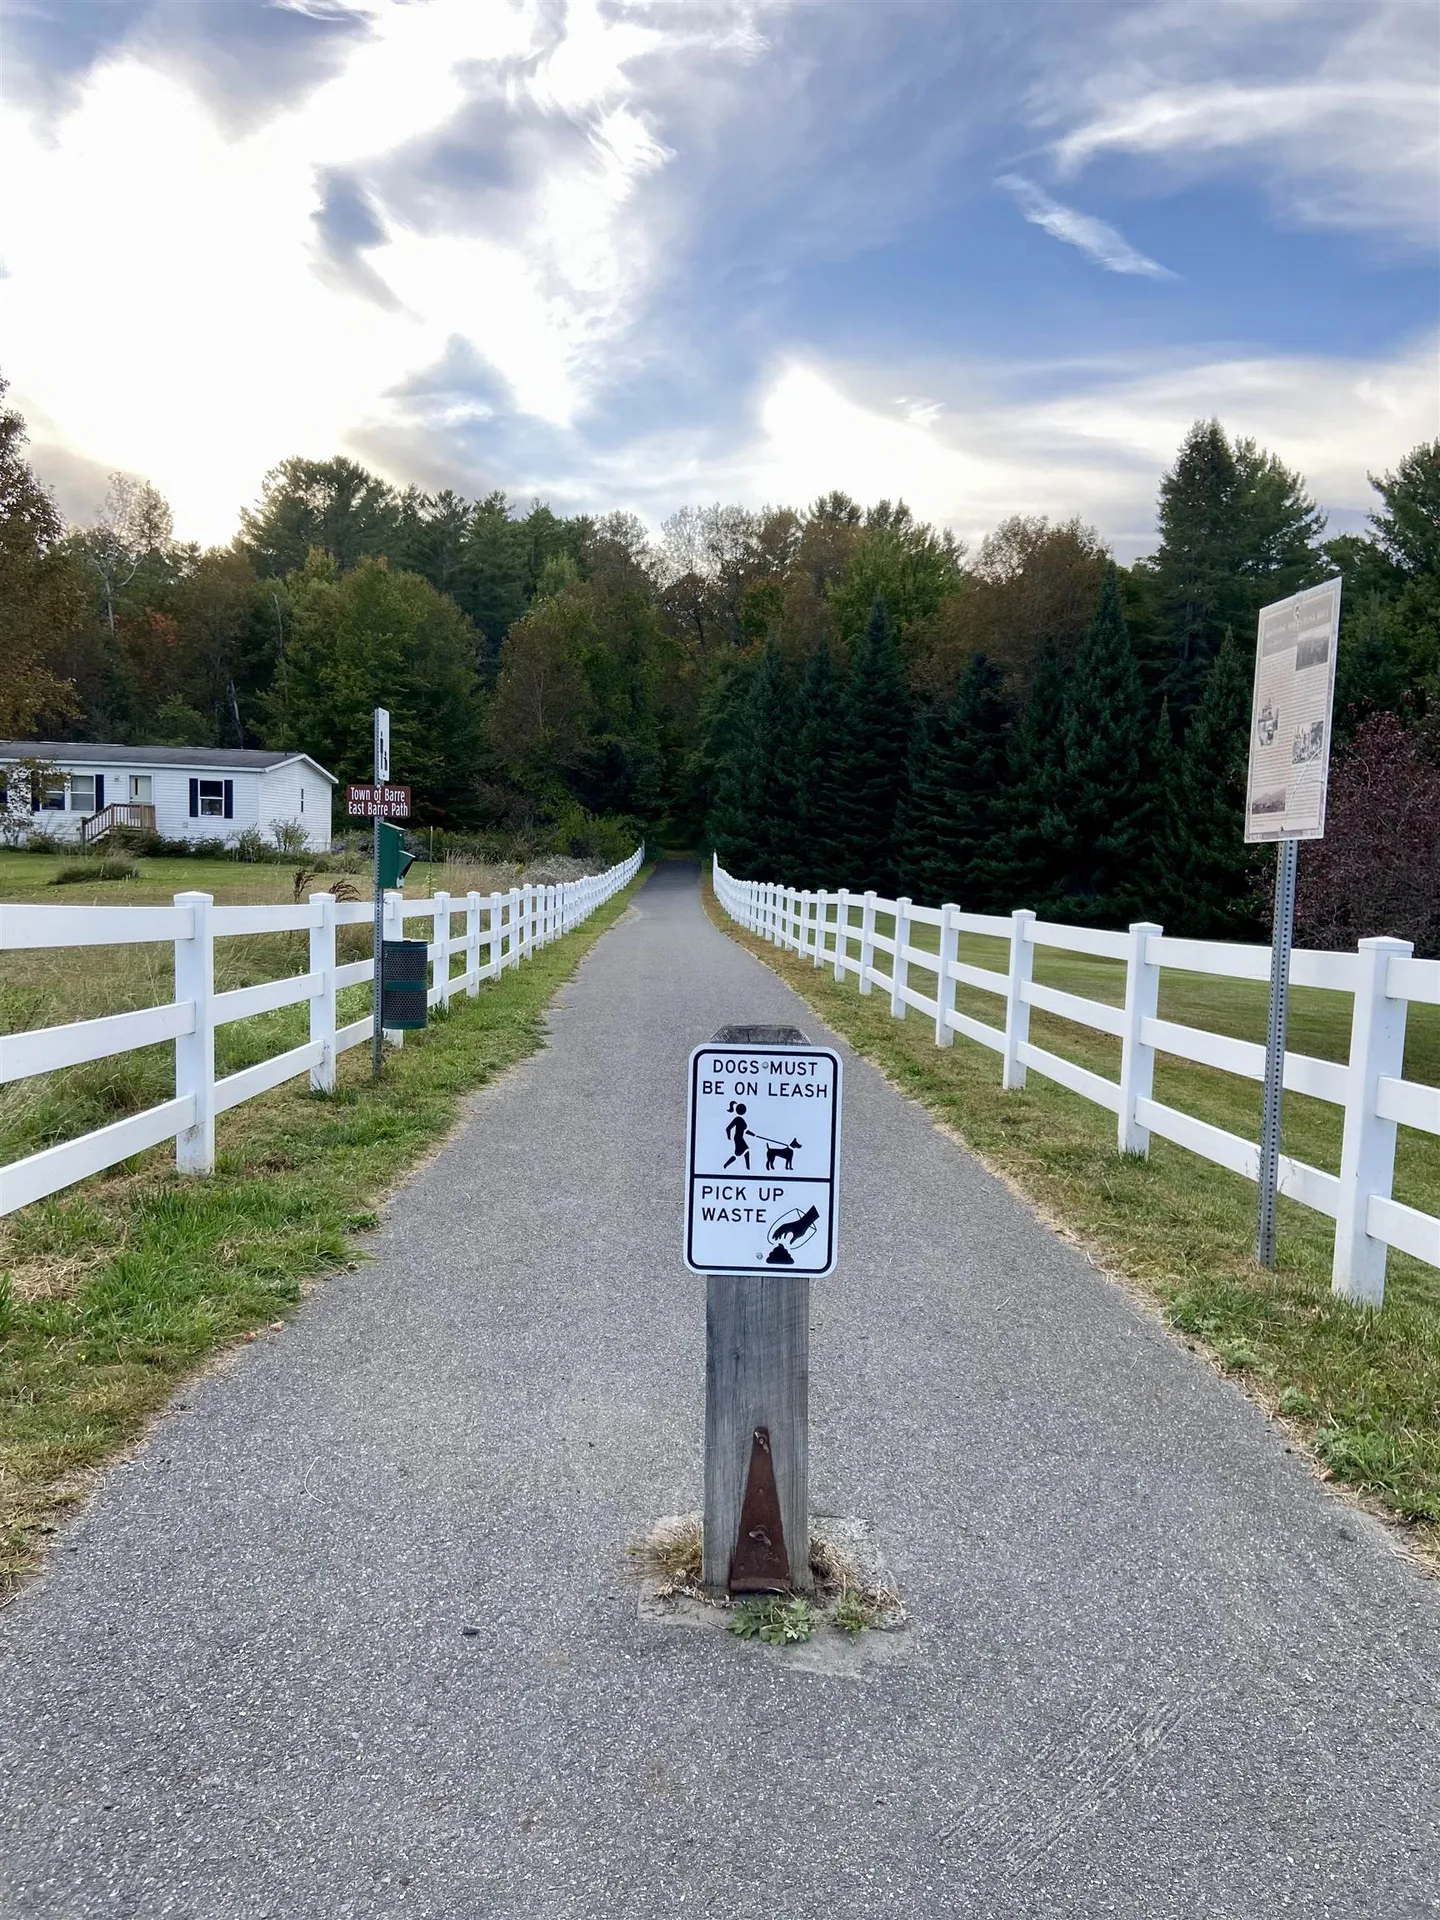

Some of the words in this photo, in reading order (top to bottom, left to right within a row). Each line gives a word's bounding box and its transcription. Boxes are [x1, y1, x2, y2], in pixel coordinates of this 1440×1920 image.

[350, 787, 370, 800] Town
[374, 788, 382, 801] of
[385, 788, 405, 802] Barre
[348, 802, 364, 815] East
[367, 802, 388, 815] Barre
[391, 803, 408, 816] Path
[713, 1059, 760, 1074] DOGS
[770, 1061, 818, 1076] MUST
[702, 1081, 725, 1095] BE
[734, 1081, 758, 1096] ON
[768, 1082, 828, 1098] LEASH
[701, 1186, 747, 1200] PICK
[758, 1187, 784, 1202] UP
[702, 1207, 767, 1223] WASTE
